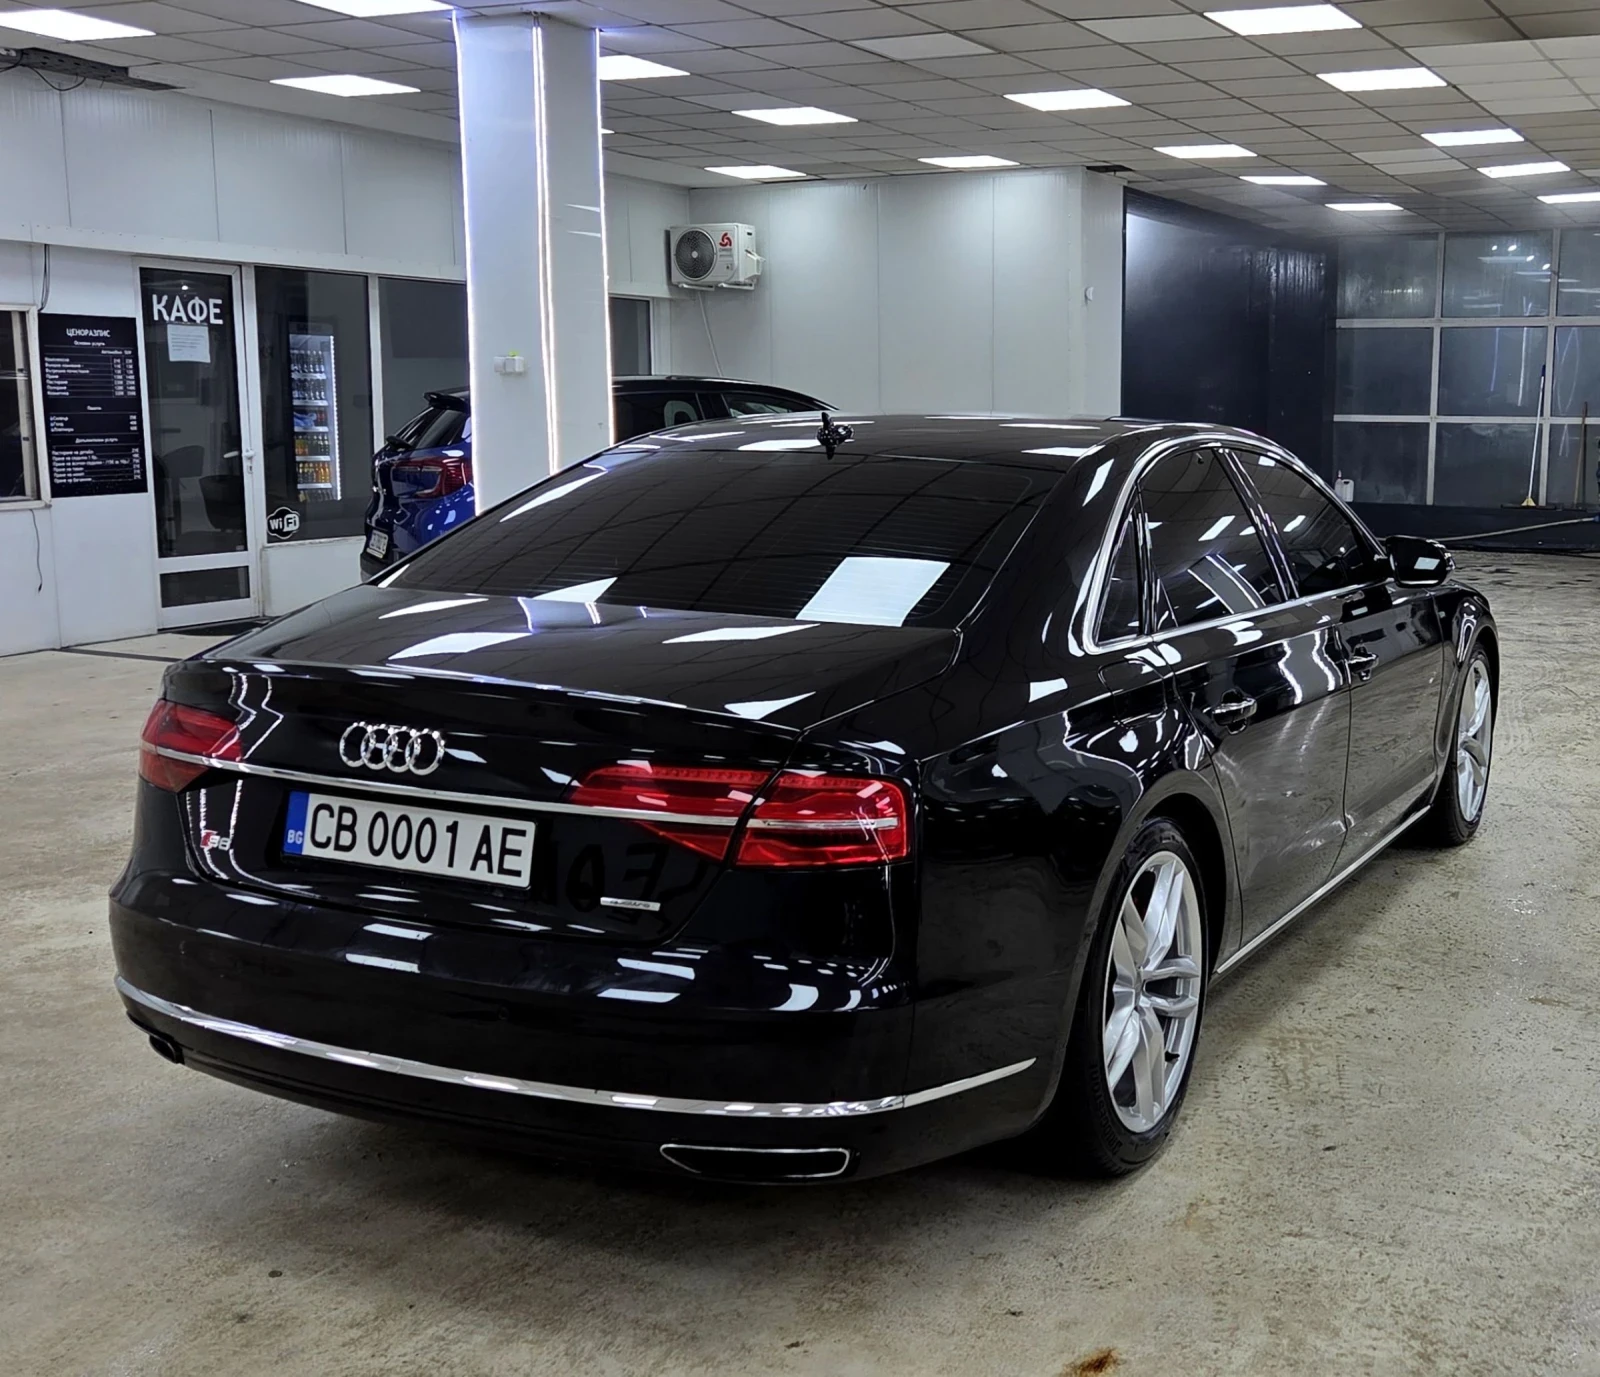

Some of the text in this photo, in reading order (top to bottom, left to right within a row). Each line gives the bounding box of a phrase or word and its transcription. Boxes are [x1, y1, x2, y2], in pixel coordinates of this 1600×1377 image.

[152, 294, 223, 325] КАФЕ
[66, 328, 111, 338] ЦЕНОРАЗПИС
[287, 829, 303, 845] BG
[367, 811, 459, 868] 0001
[470, 824, 527, 878] AE
